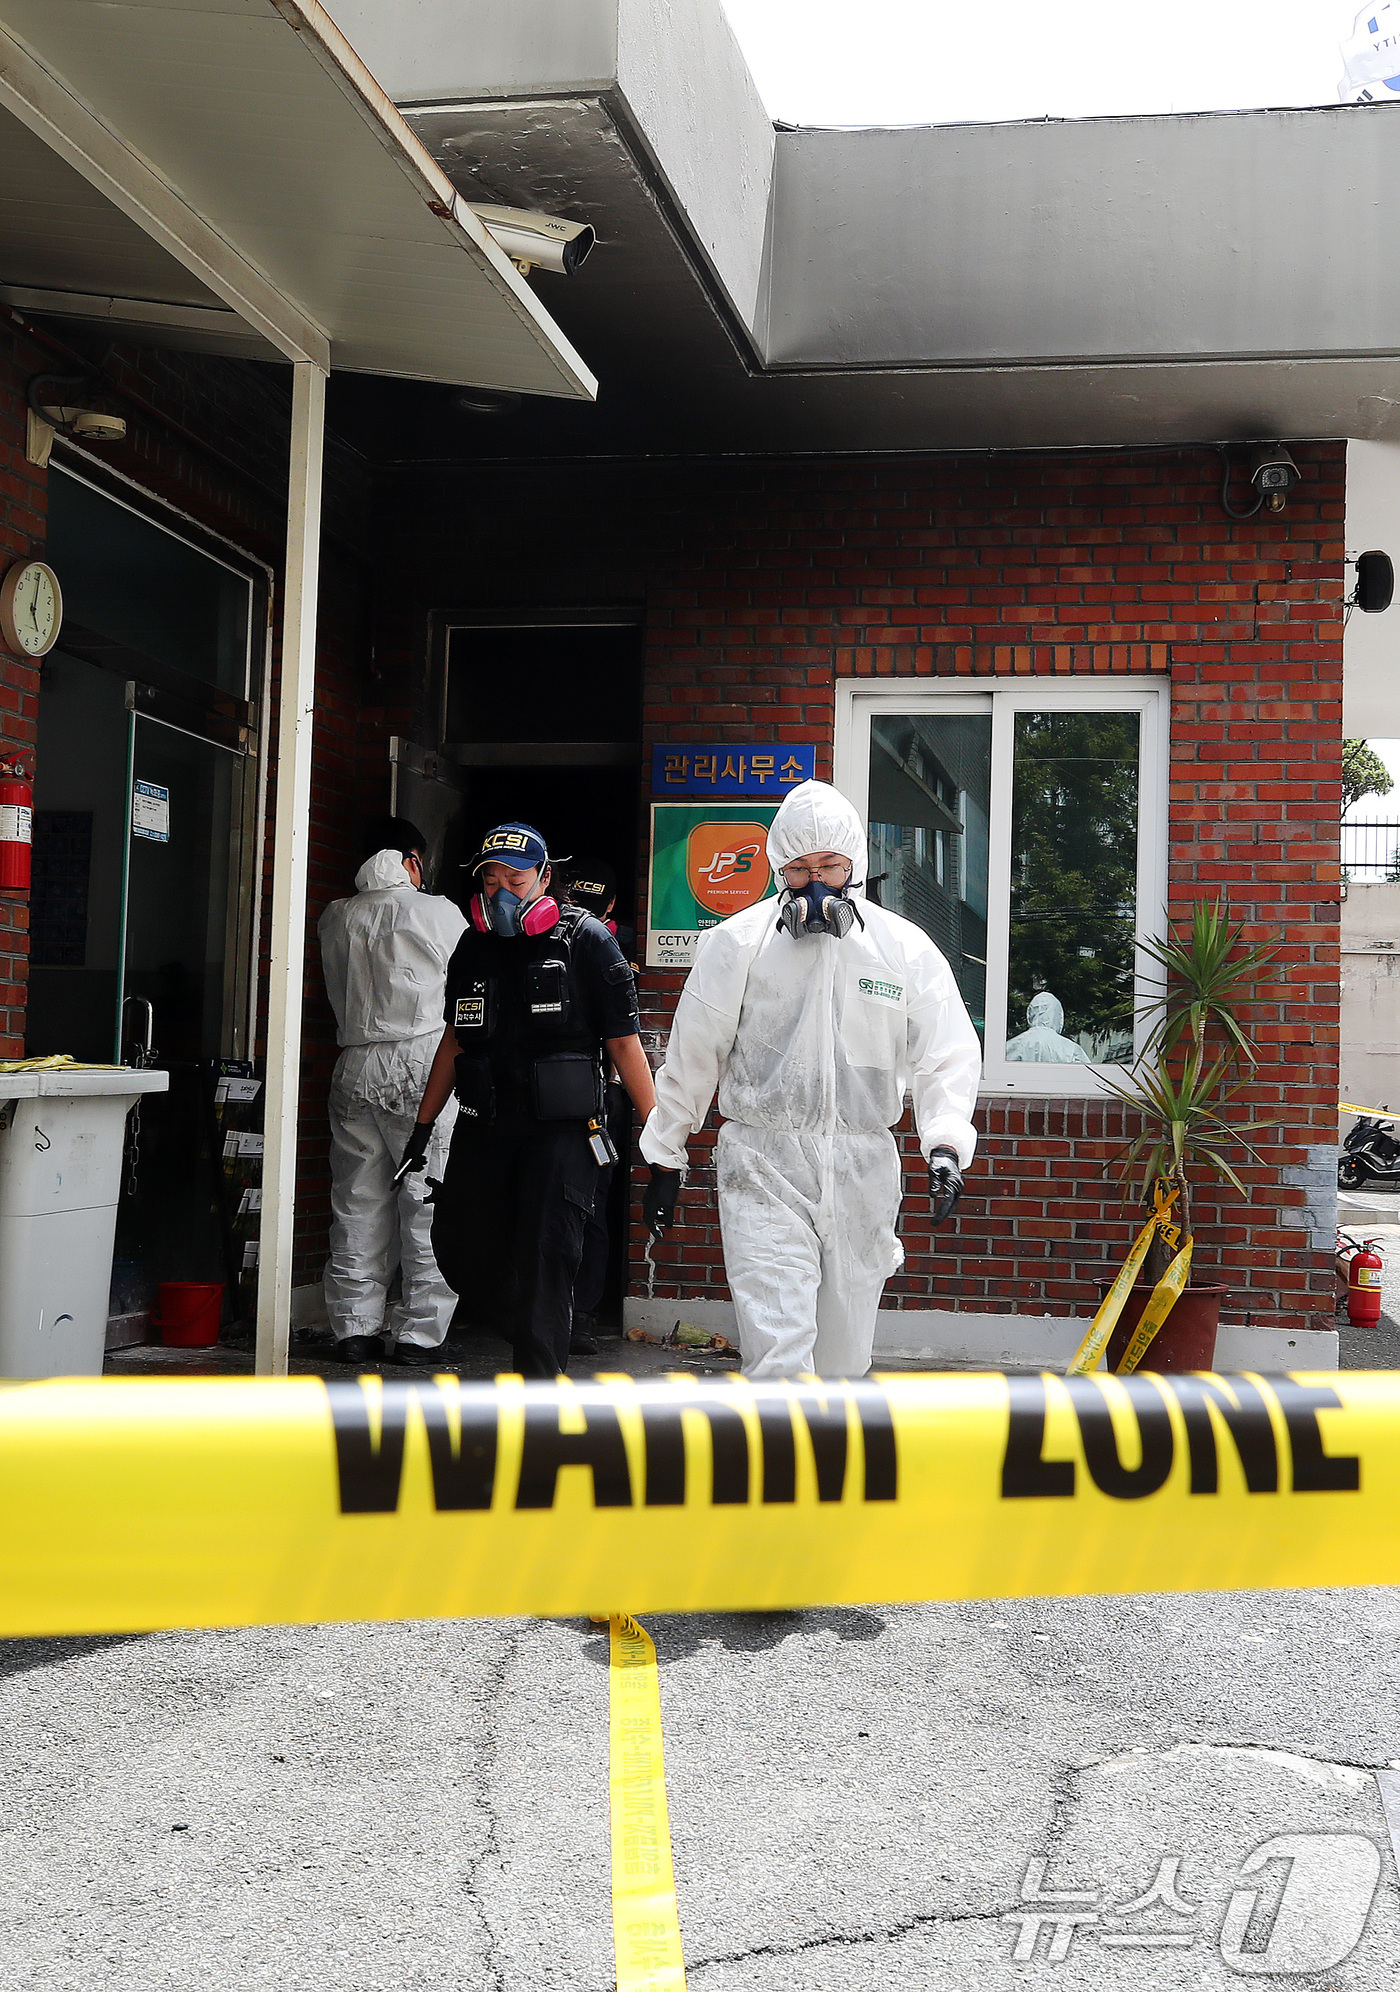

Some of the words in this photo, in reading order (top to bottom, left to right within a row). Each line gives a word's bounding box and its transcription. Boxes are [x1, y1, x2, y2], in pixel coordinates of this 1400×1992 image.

[545, 222, 566, 232] JWC
[664, 755, 804, 784] 관리사무소
[481, 833, 529, 851] KCSI
[697, 851, 756, 874] JPS
[574, 880, 606, 893] KCSI
[658, 935, 691, 946] CCTV
[459, 1002, 482, 1011] KCSI
